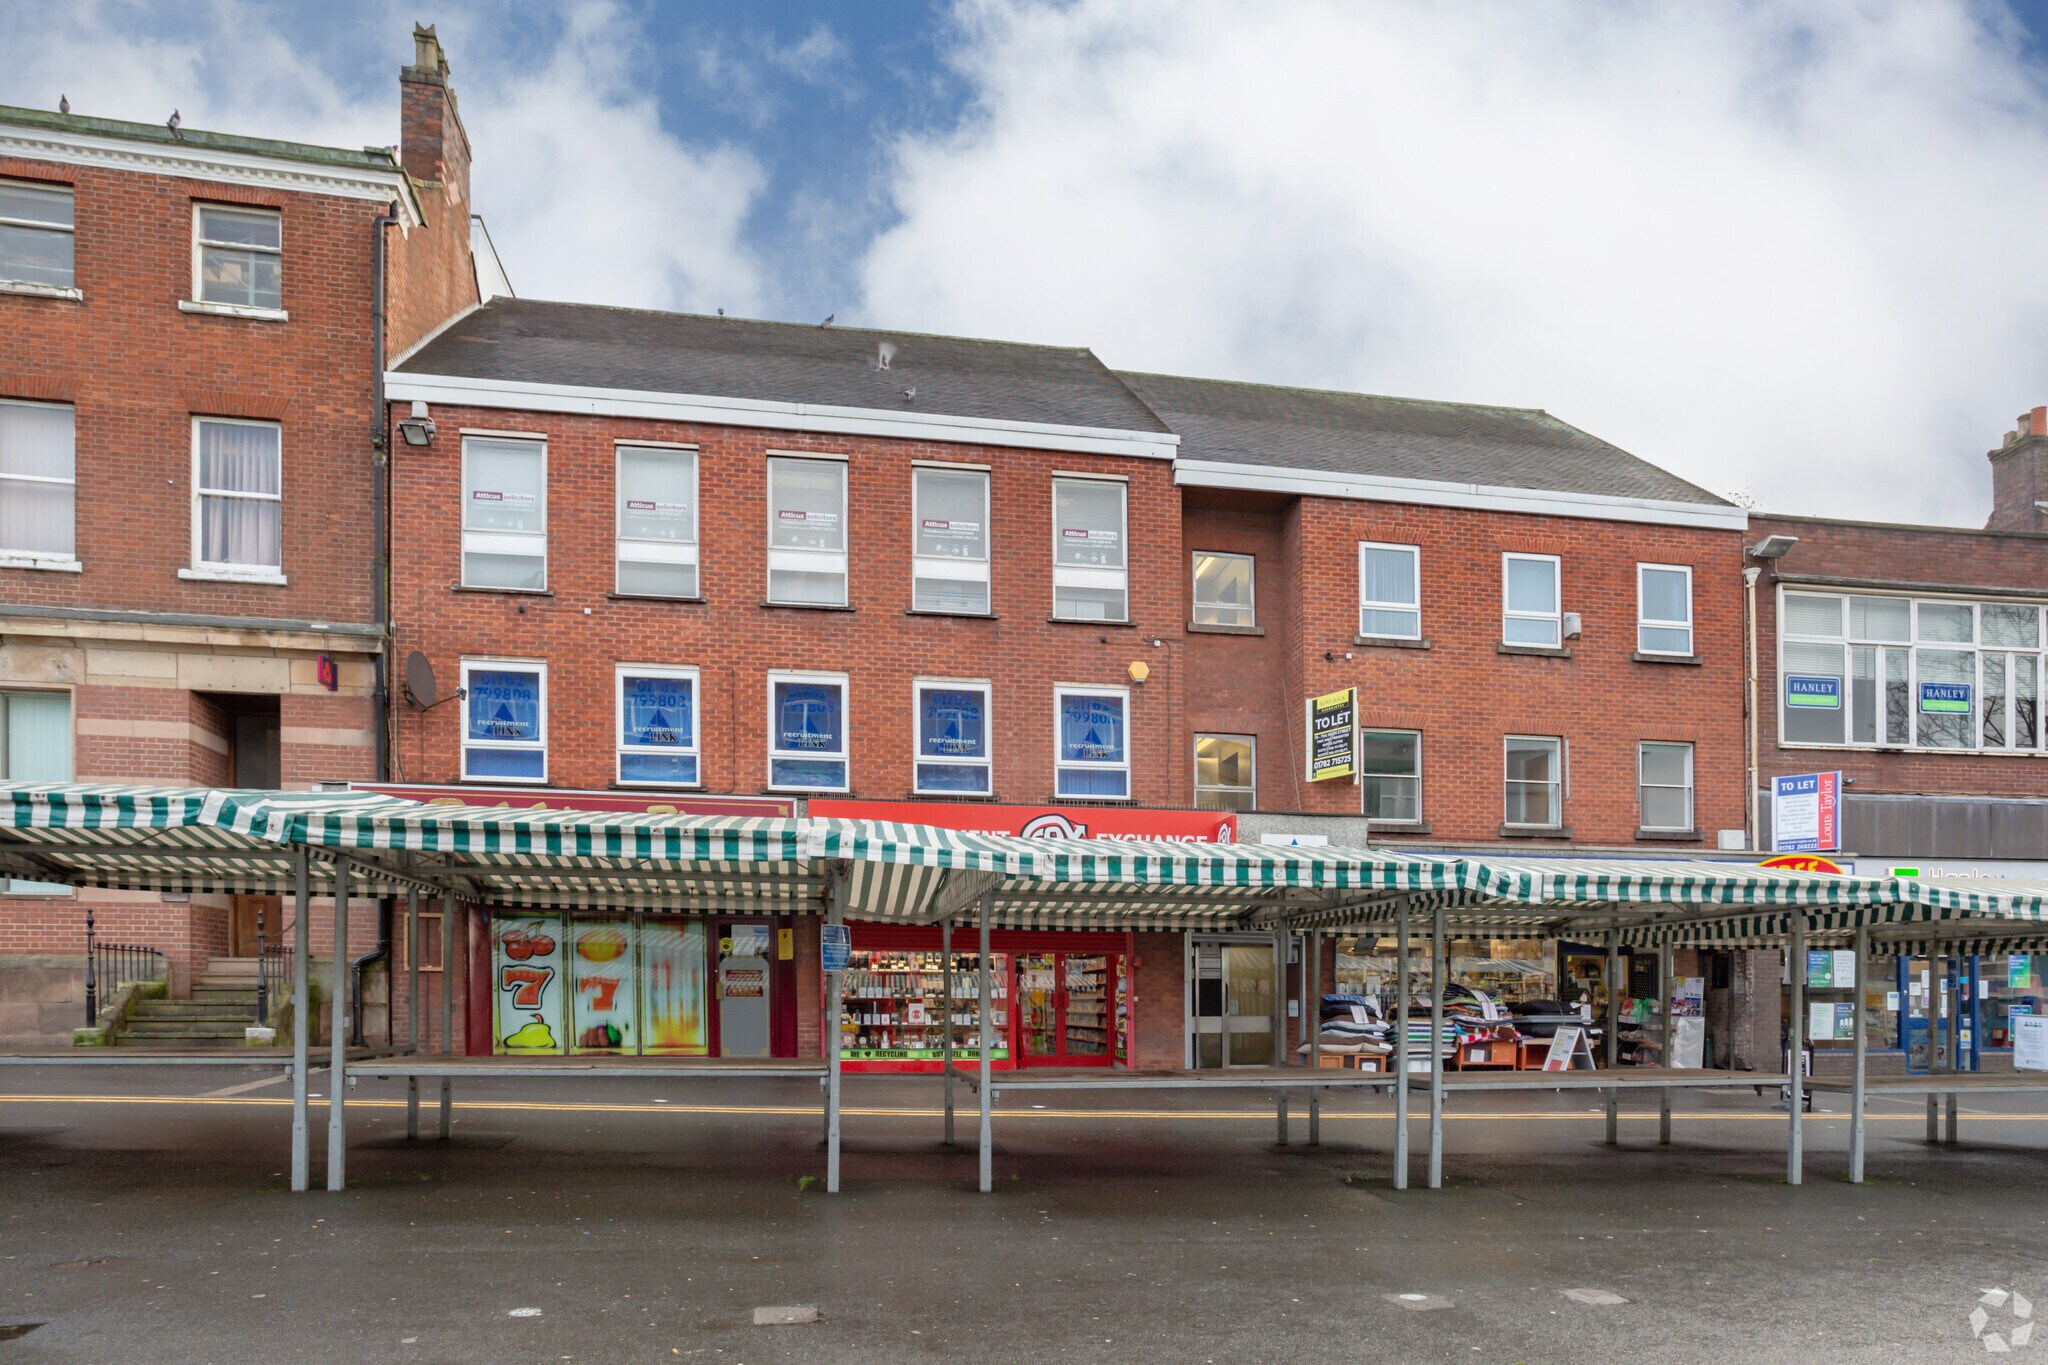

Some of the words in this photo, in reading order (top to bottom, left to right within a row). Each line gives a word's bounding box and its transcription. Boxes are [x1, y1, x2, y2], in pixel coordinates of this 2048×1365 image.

[475, 492, 501, 500] Atticus
[504, 494, 535, 502] solicitors
[629, 502, 654, 510] Atticus
[656, 504, 687, 512] solicitors
[781, 511, 805, 519] Atticus
[806, 513, 837, 521] solicitors
[1793, 682, 1834, 693] HANLEY
[1926, 688, 1965, 699] HANLEY
[630, 694, 686, 708] 799808
[477, 719, 529, 727] recruitment
[1315, 717, 1330, 730] TO
[1331, 711, 1351, 726] LET
[494, 726, 523, 736] LINK
[633, 726, 684, 734] recruitment
[783, 731, 833, 739] recruitment
[649, 732, 677, 742] LINK
[798, 738, 827, 748] LINK
[943, 743, 970, 753] LINK
[1083, 749, 1109, 758] LINK
[1314, 759, 1330, 769] 01782
[1331, 754, 1352, 766] 715725
[1781, 782, 1794, 791] TO
[1797, 780, 1815, 790] LET
[1820, 779, 1836, 813] Taylor
[1820, 814, 1833, 844] Louis
[1796, 842, 1818, 850] 260222
[850, 1050, 860, 1058] WE
[875, 1050, 908, 1058] RECYCLING
